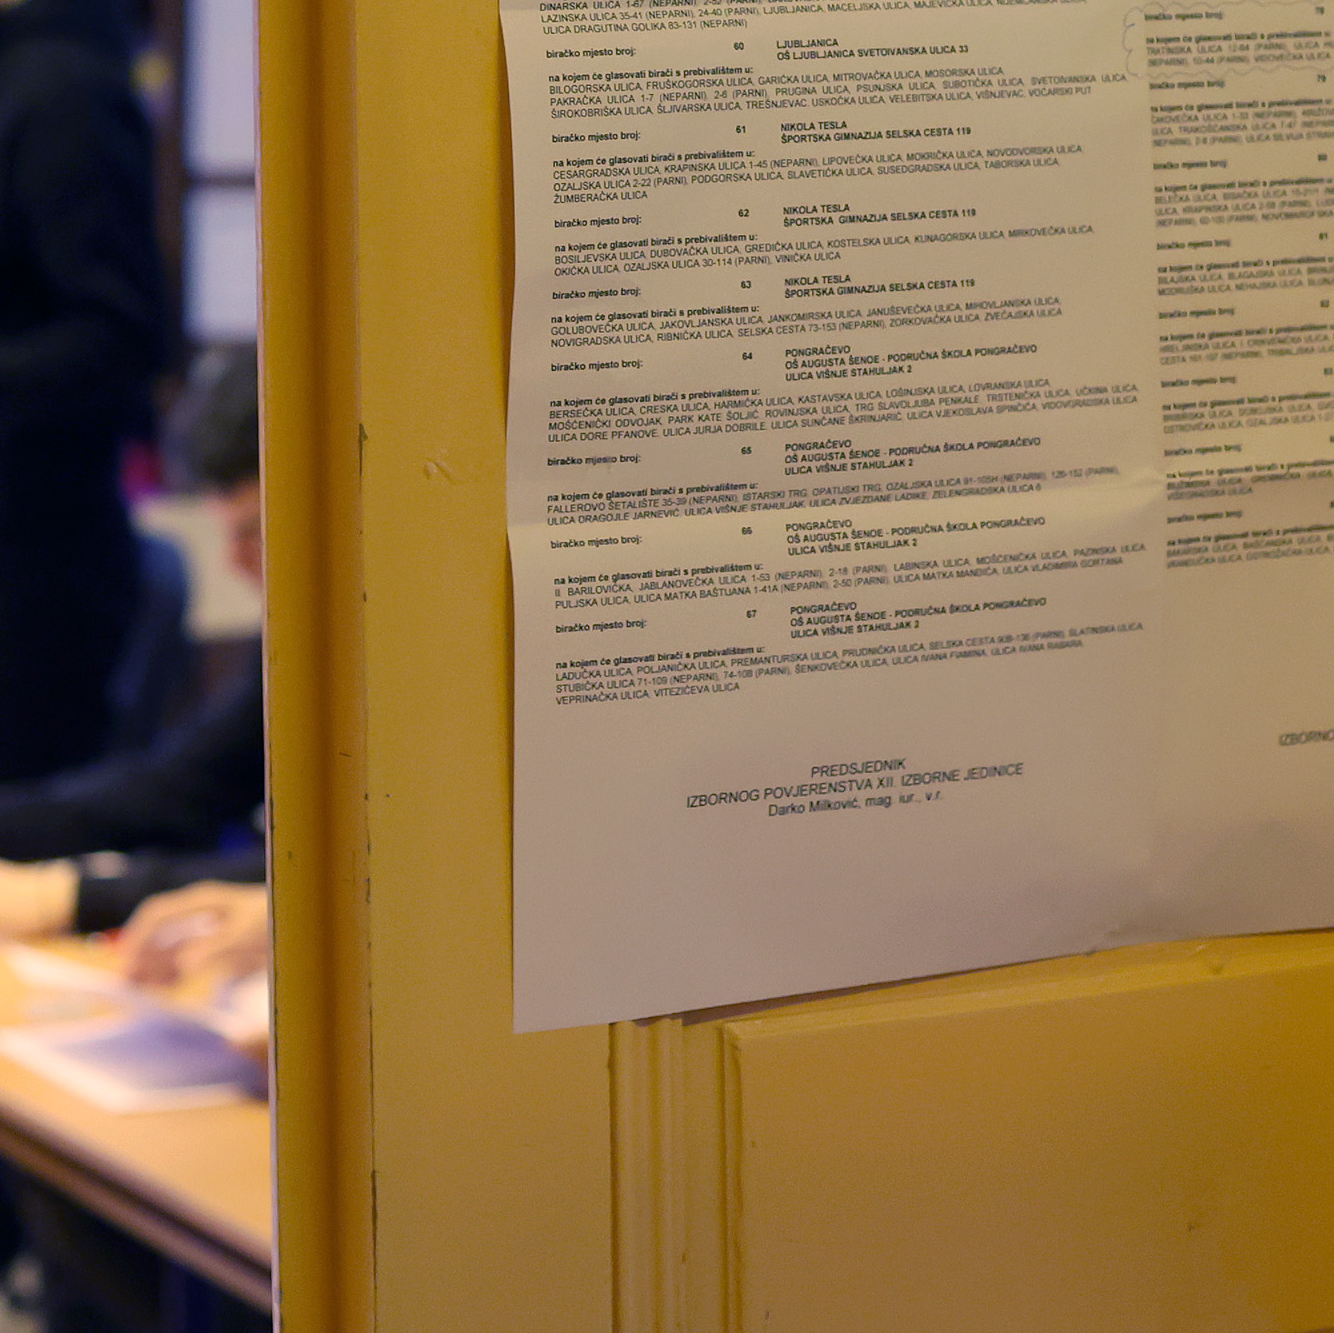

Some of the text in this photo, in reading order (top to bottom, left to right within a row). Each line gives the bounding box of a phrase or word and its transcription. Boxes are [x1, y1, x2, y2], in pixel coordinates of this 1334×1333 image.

[542, 18, 747, 34] ULICA DRAGUTINA GOLIKA 83-131 (NEPARNI)
[553, 190, 647, 204] ŽUMBERAČKA ULICA
[782, 203, 850, 214] NIKOLA TESLA
[784, 278, 975, 298] ŠPORTSKA GIMNAZIJA SELSKA CESTA 119
[784, 345, 851, 357] PONGRAČEVO
[784, 359, 798, 369] OŠ
[800, 357, 846, 368] AUGUSTA
[848, 354, 879, 365] ŠENOE
[887, 351, 939, 362] PODRUČNA
[940, 348, 972, 359] ŠKOLA
[974, 343, 1037, 356] PONGRAČEVO
[550, 351, 752, 371] biračko mjesto broj: 64
[785, 371, 813, 381] ULICA
[815, 368, 848, 379] VIŠNJE
[850, 365, 904, 377] STAHULJAK
[810, 757, 905, 778] PREDSJEDNIK
[686, 762, 1023, 808] IZBORNOG POVJERENSTVA XII. IZBORNE JEDINICE
[768, 802, 805, 816] Darko
